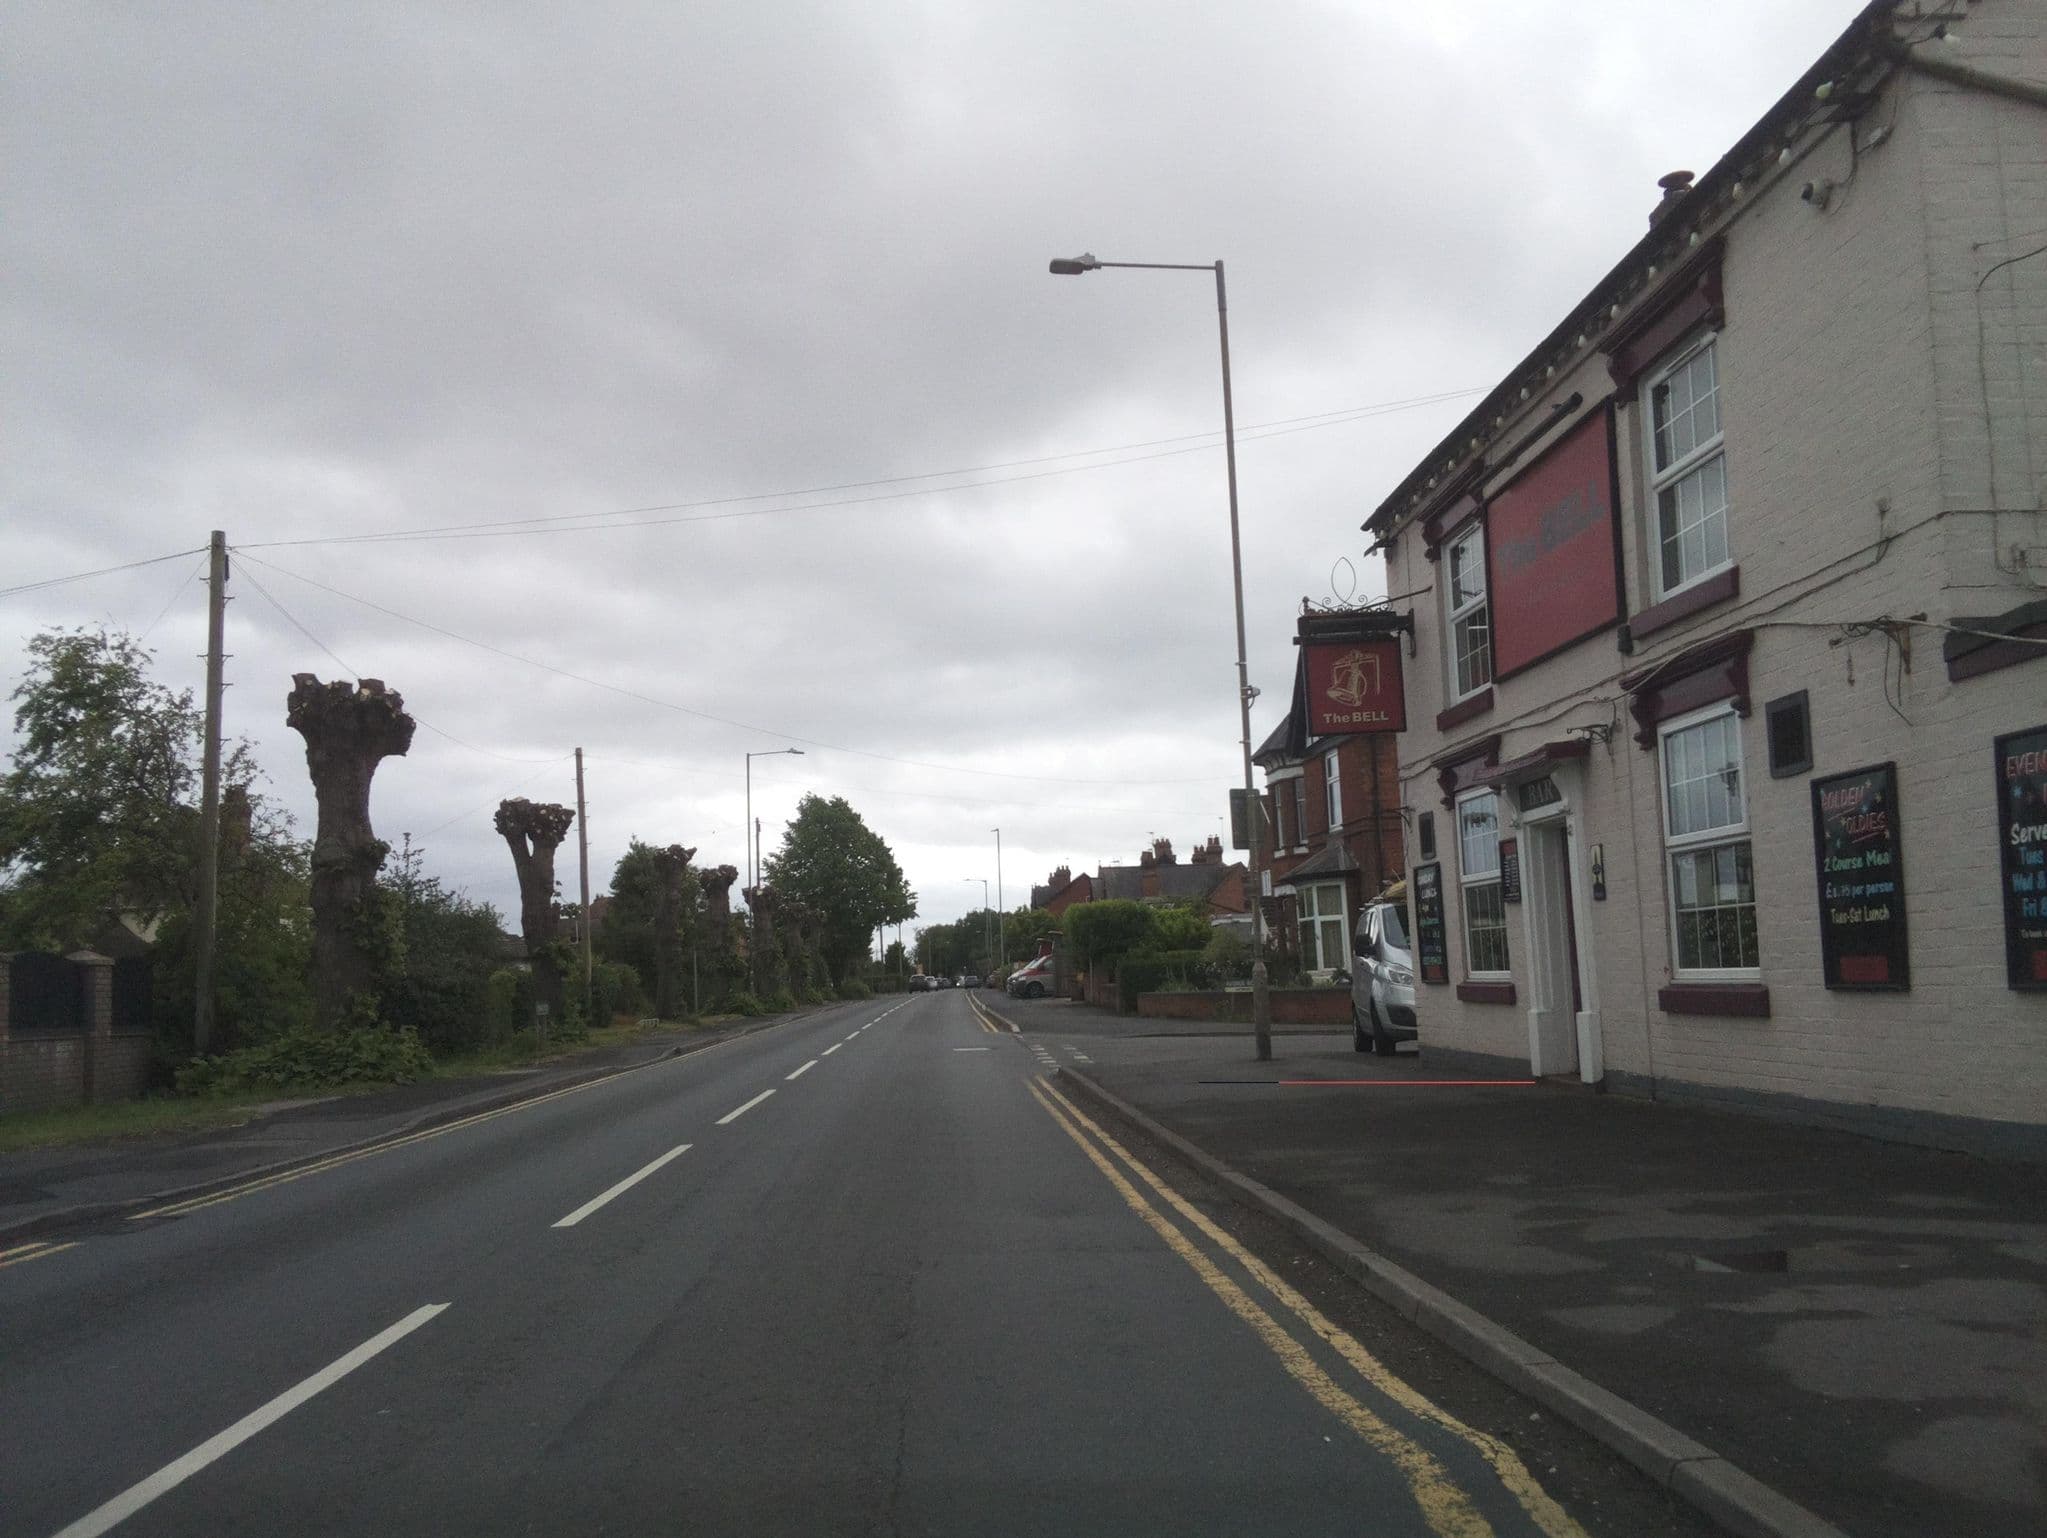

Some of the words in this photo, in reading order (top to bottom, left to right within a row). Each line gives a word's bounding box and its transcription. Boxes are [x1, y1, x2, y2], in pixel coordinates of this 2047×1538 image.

[1323, 713, 1350, 724] The
[1352, 711, 1389, 722] BELL
[1824, 857, 1831, 872] 2
